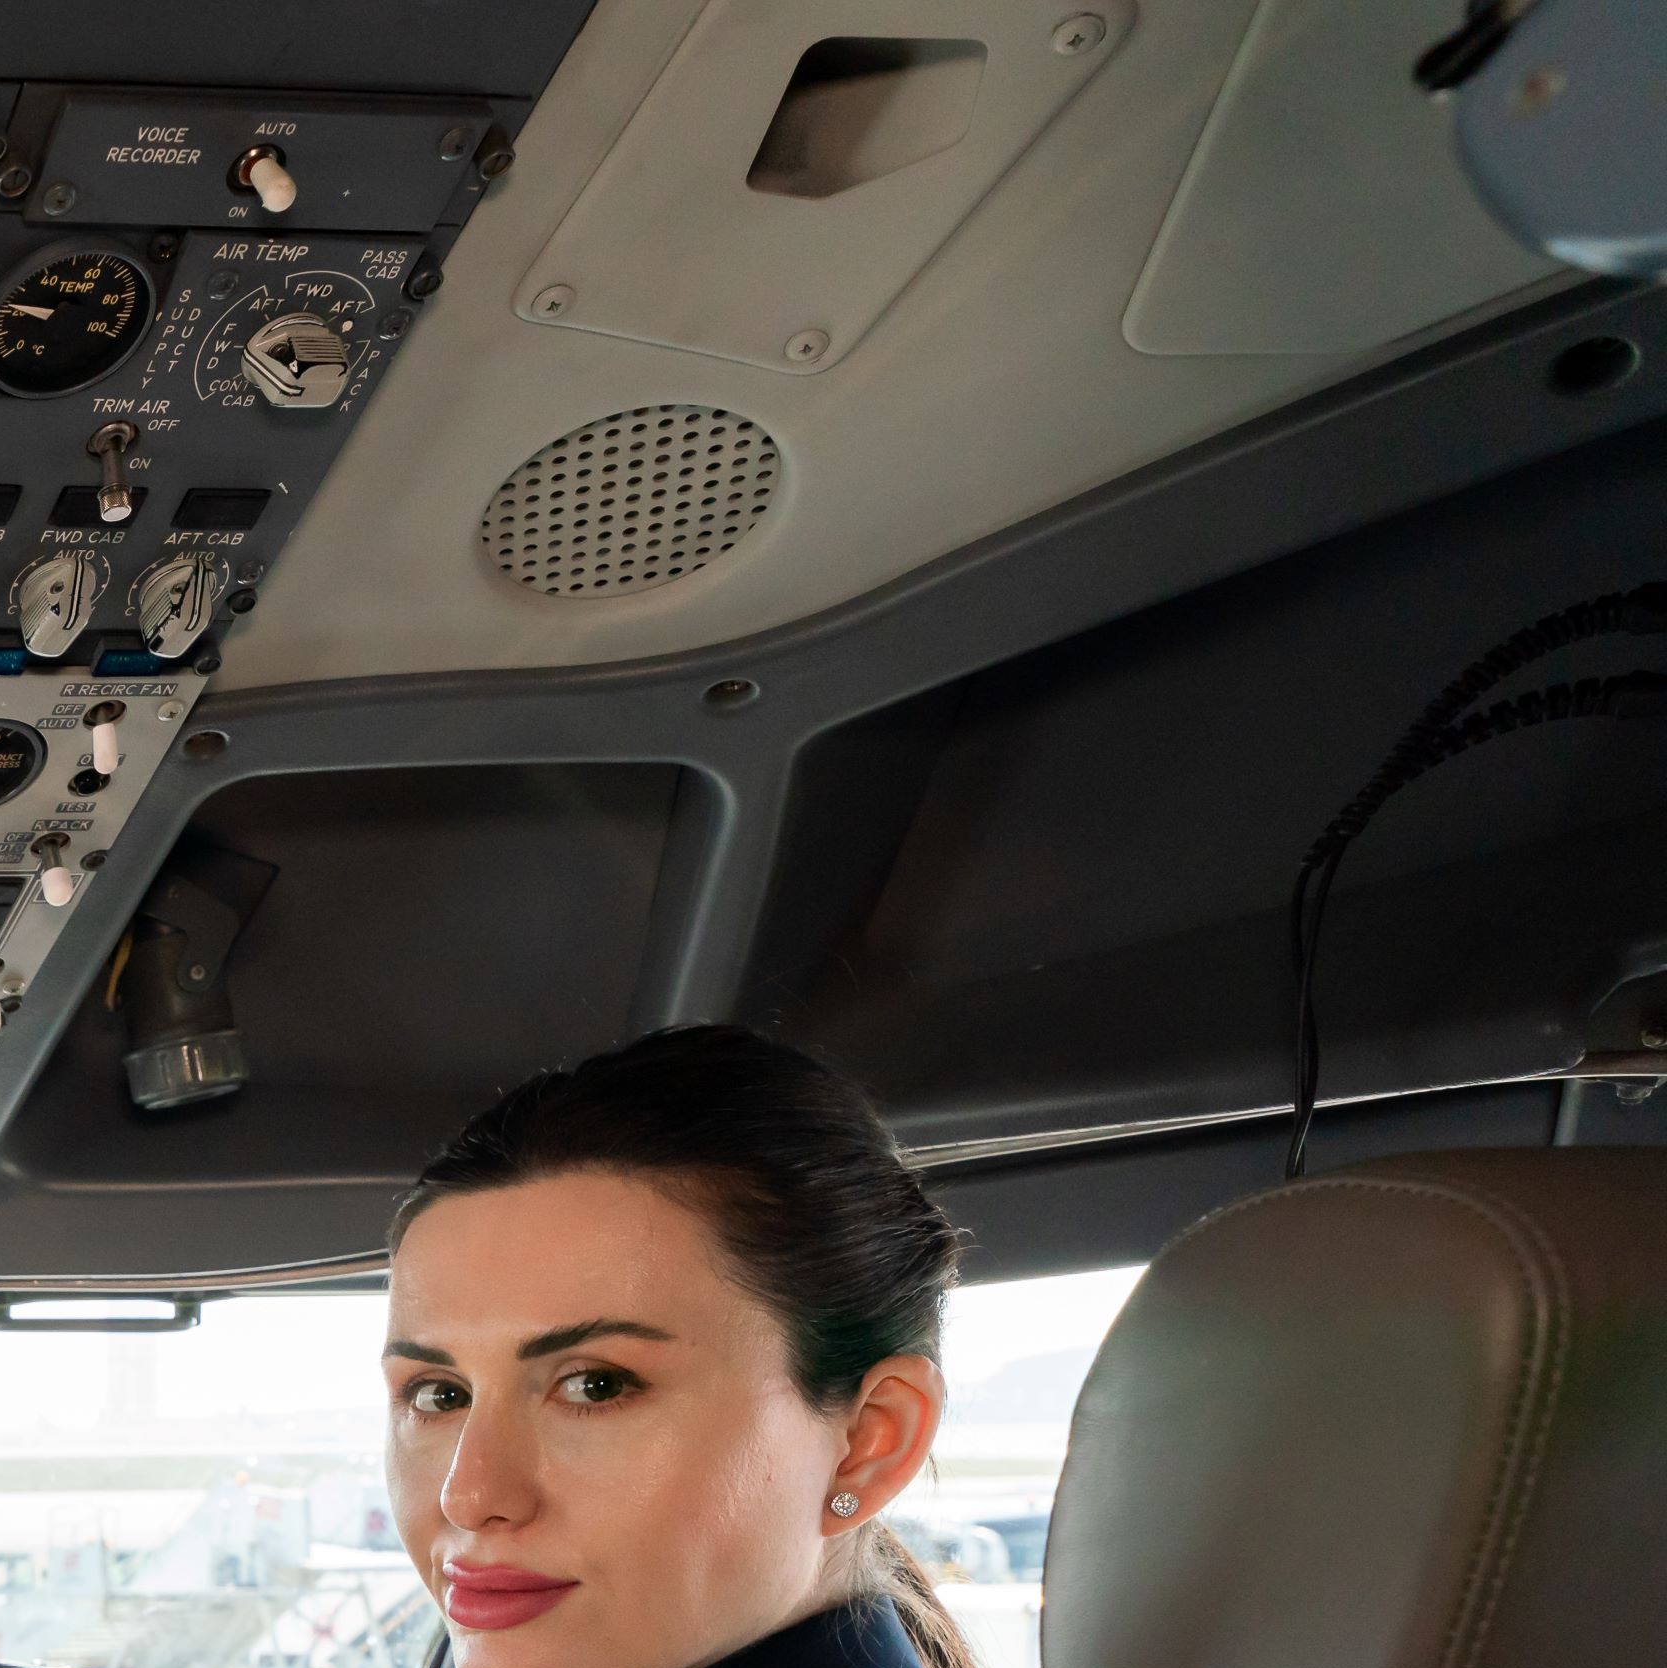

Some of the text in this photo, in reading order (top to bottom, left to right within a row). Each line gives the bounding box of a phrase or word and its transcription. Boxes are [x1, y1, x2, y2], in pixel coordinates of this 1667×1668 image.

[136, 127, 189, 143] VOICE
[254, 123, 296, 136] AUTO
[105, 148, 202, 165] RECORDER
[213, 244, 309, 262] AIR TEMP
[359, 250, 408, 265] PASS
[365, 265, 401, 280] CAB
[59, 280, 95, 293] TEMP
[293, 284, 333, 298] FWD
[86, 321, 108, 333] 100
[91, 398, 171, 414] TRIM AIR
[40, 529, 125, 545] FWD CAB
[164, 532, 244, 546] AFT CAB
[64, 684, 176, 696] R RECIRC FAN
[60, 803, 94, 812] TEST
